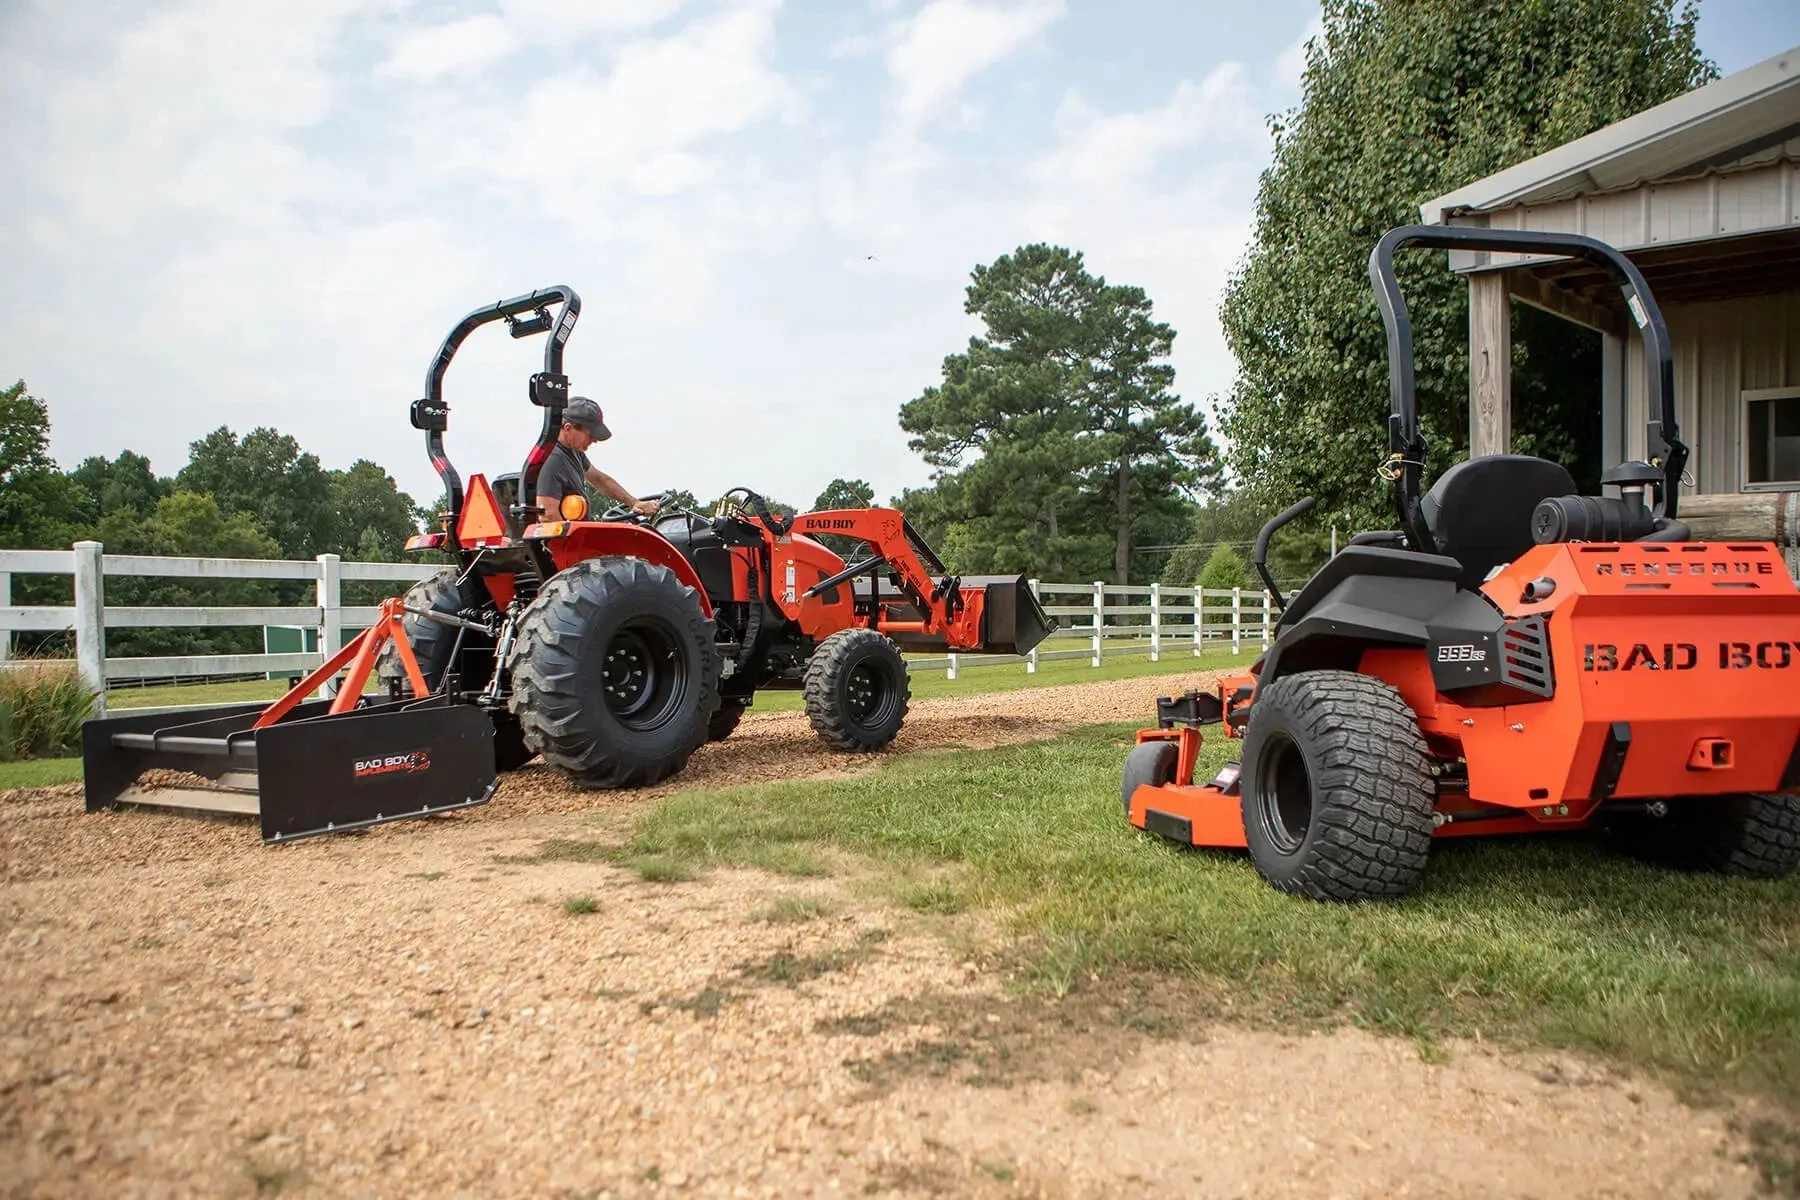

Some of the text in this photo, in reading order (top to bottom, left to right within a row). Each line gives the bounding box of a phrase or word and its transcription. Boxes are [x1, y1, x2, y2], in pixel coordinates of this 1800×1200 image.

[806, 519, 856, 529] BAD BOY
[1597, 561, 1773, 576] RENEGADE
[1584, 641, 1800, 671] BAD BO
[355, 754, 411, 771] BAD BOY
